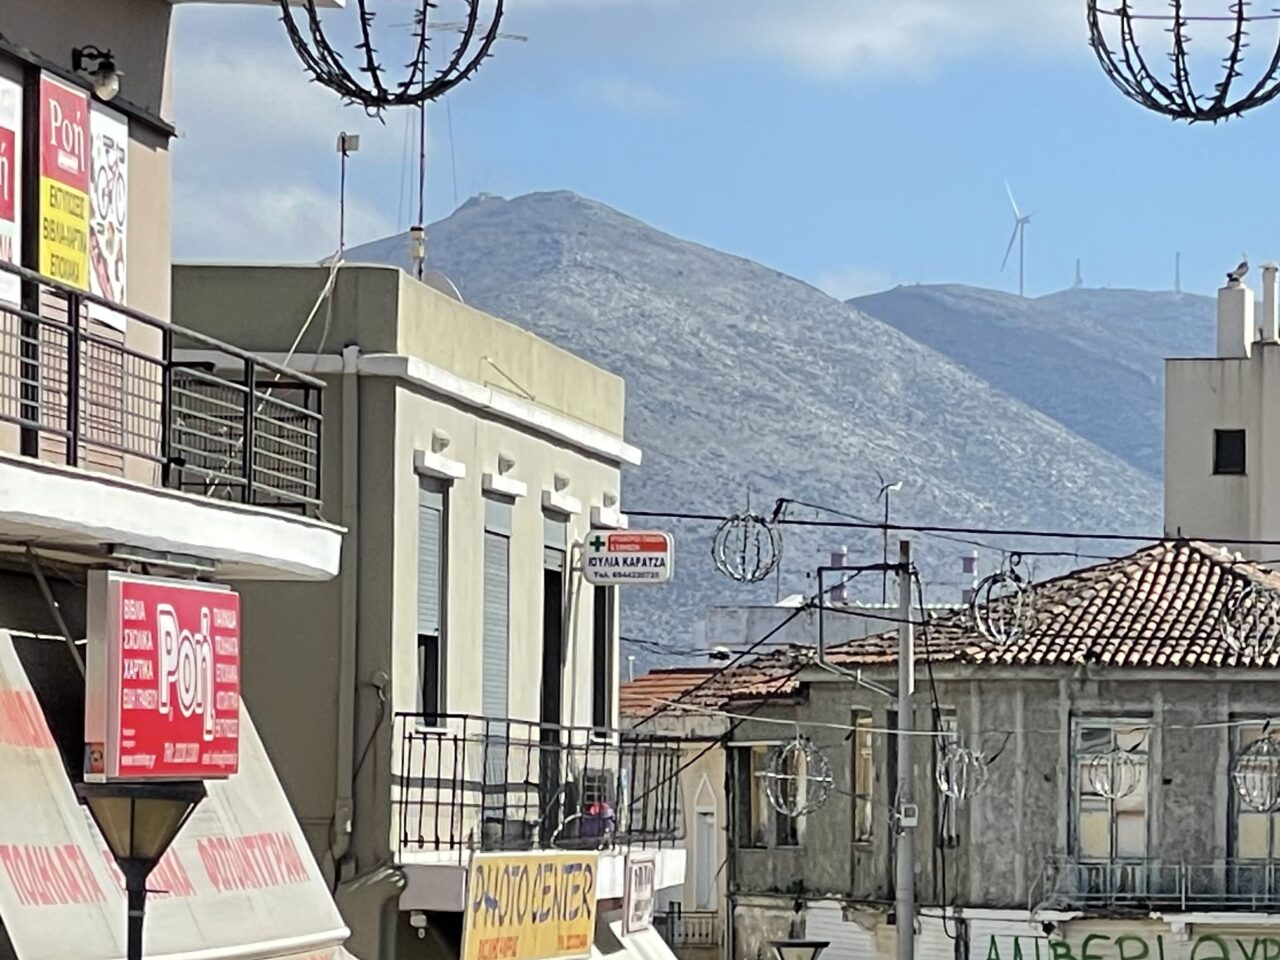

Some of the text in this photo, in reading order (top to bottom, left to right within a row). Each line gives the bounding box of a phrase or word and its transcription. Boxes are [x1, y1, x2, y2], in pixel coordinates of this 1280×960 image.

[48, 97, 86, 173] Ροή
[588, 556, 666, 568] ΙΟΥΛΙΑ ΚΑΡΑΤΖΑ
[123, 628, 154, 651] ΣΧΟΛΙΚΑ
[123, 658, 154, 680] ΧΑΡΤΙΚΑ
[157, 603, 215, 742] Ροή
[472, 864, 530, 930] PHOTO
[531, 862, 593, 925] CENTER
